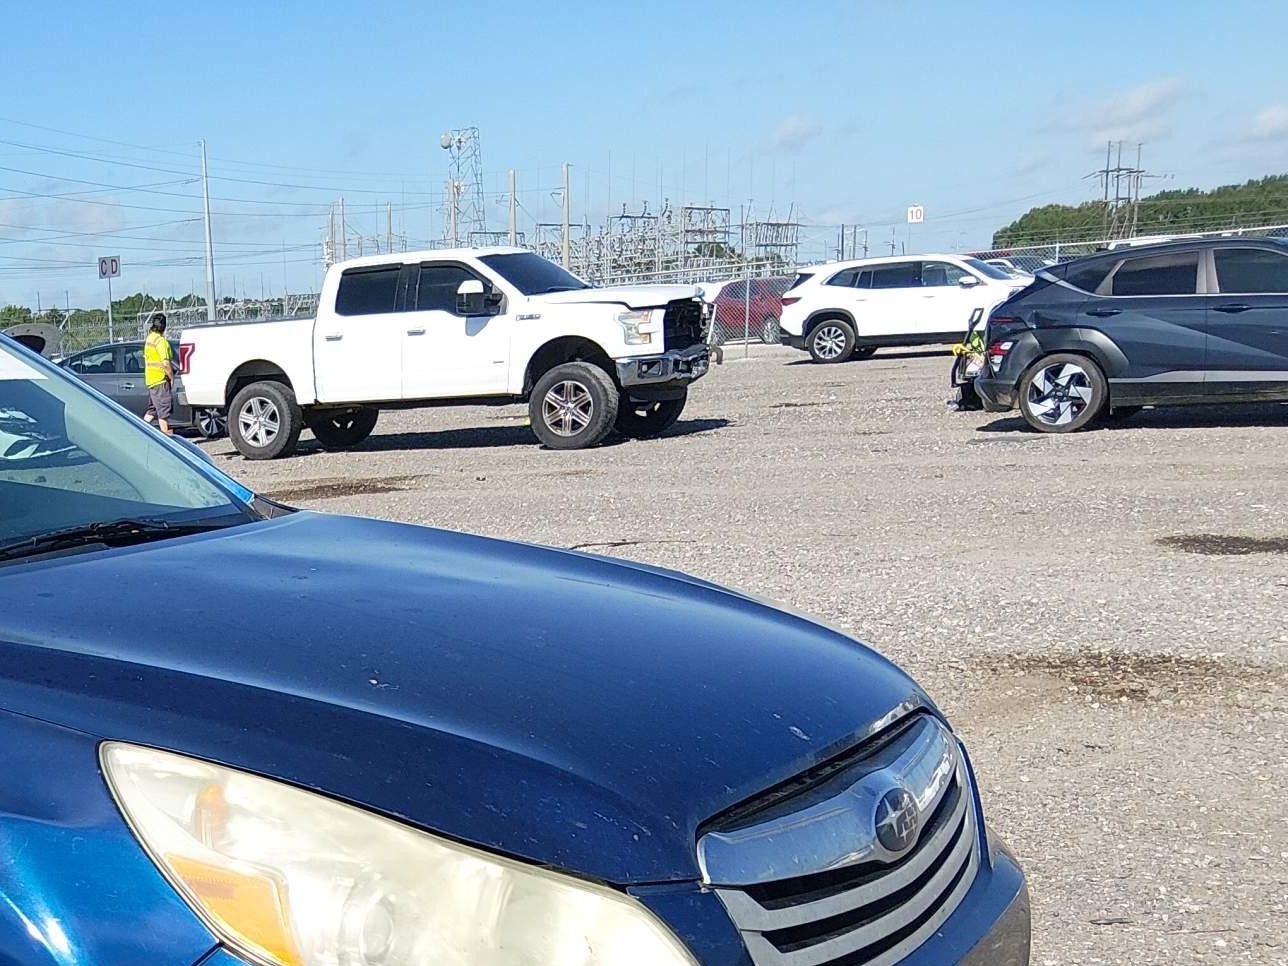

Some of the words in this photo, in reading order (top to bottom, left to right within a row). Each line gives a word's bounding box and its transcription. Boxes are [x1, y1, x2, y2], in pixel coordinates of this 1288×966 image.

[909, 209, 922, 220] 10
[100, 259, 108, 276] C
[110, 258, 118, 275] D
